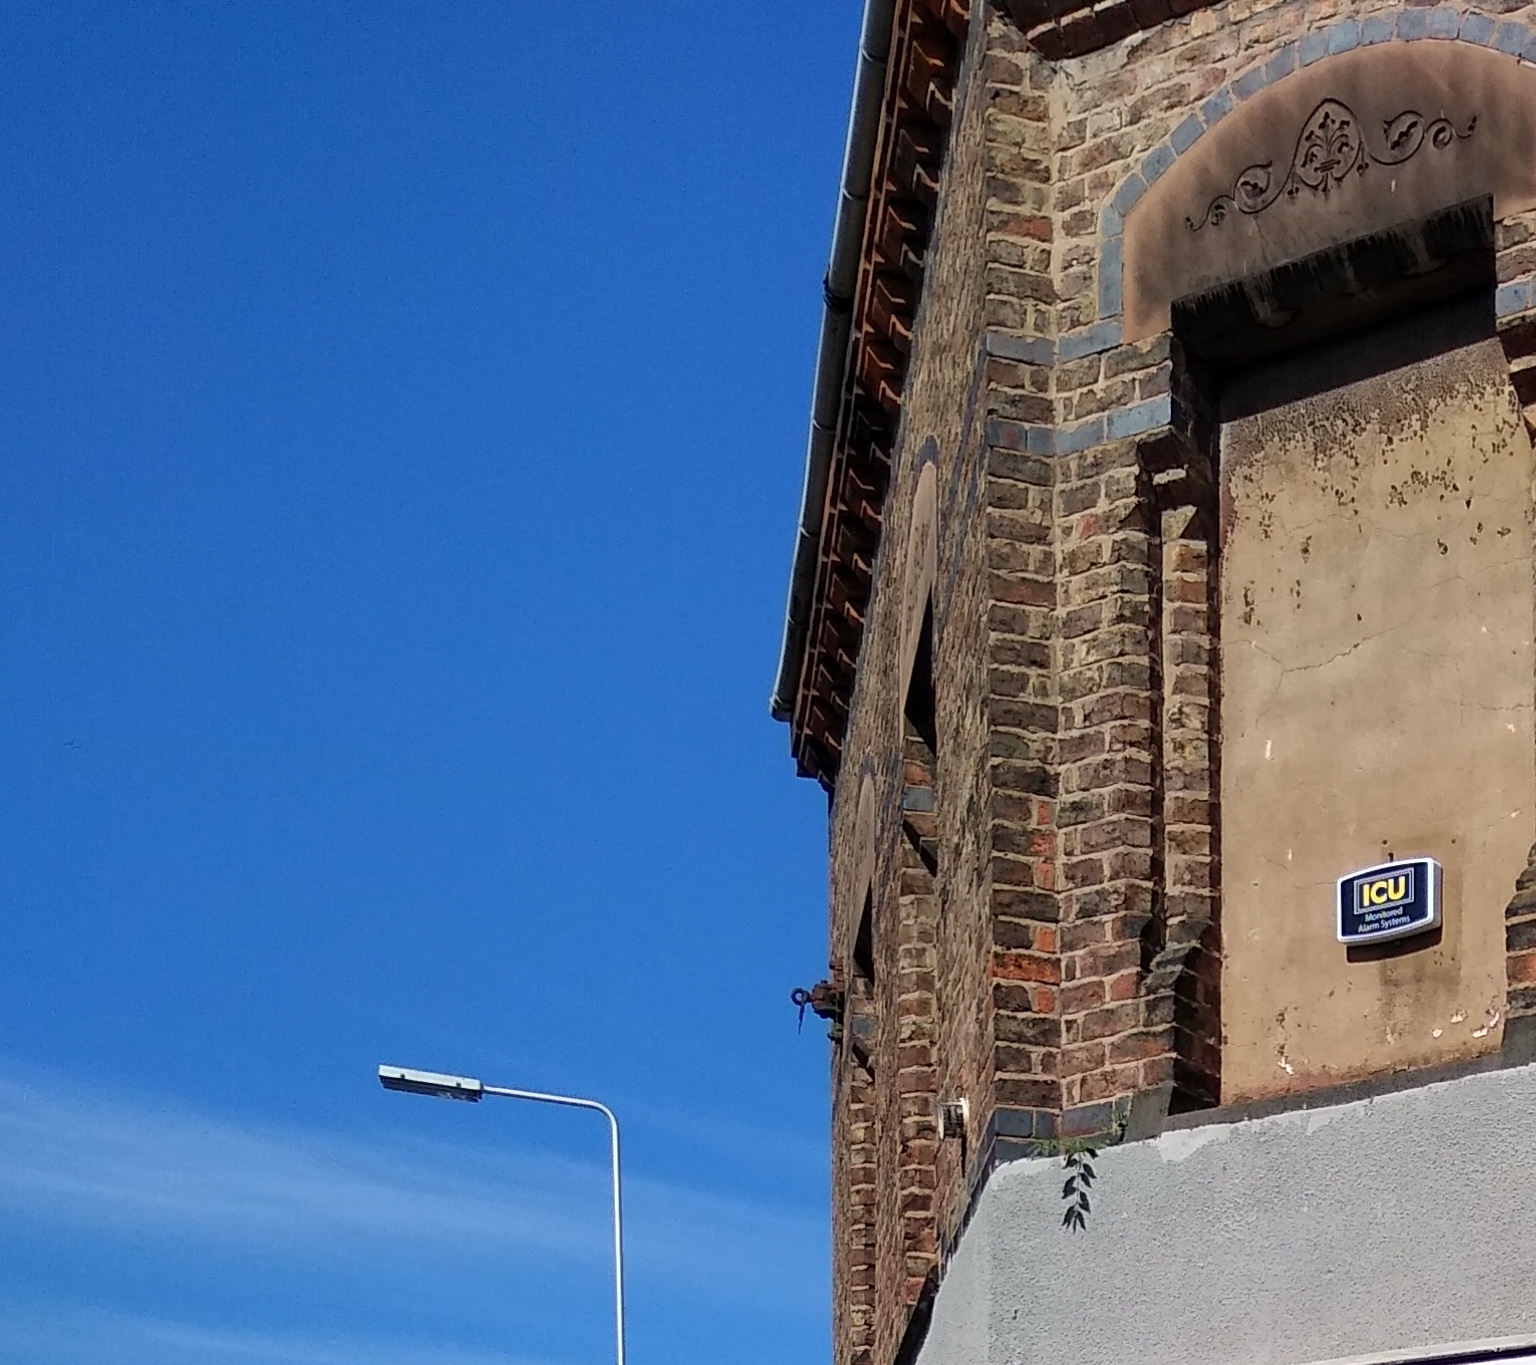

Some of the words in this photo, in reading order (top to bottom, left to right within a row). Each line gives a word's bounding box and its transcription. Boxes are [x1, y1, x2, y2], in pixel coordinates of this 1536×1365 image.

[1363, 876, 1405, 907] ICU
[1358, 919, 1380, 933] Alarm
[1380, 914, 1411, 929] Systems
[1365, 906, 1403, 922] Monitored
